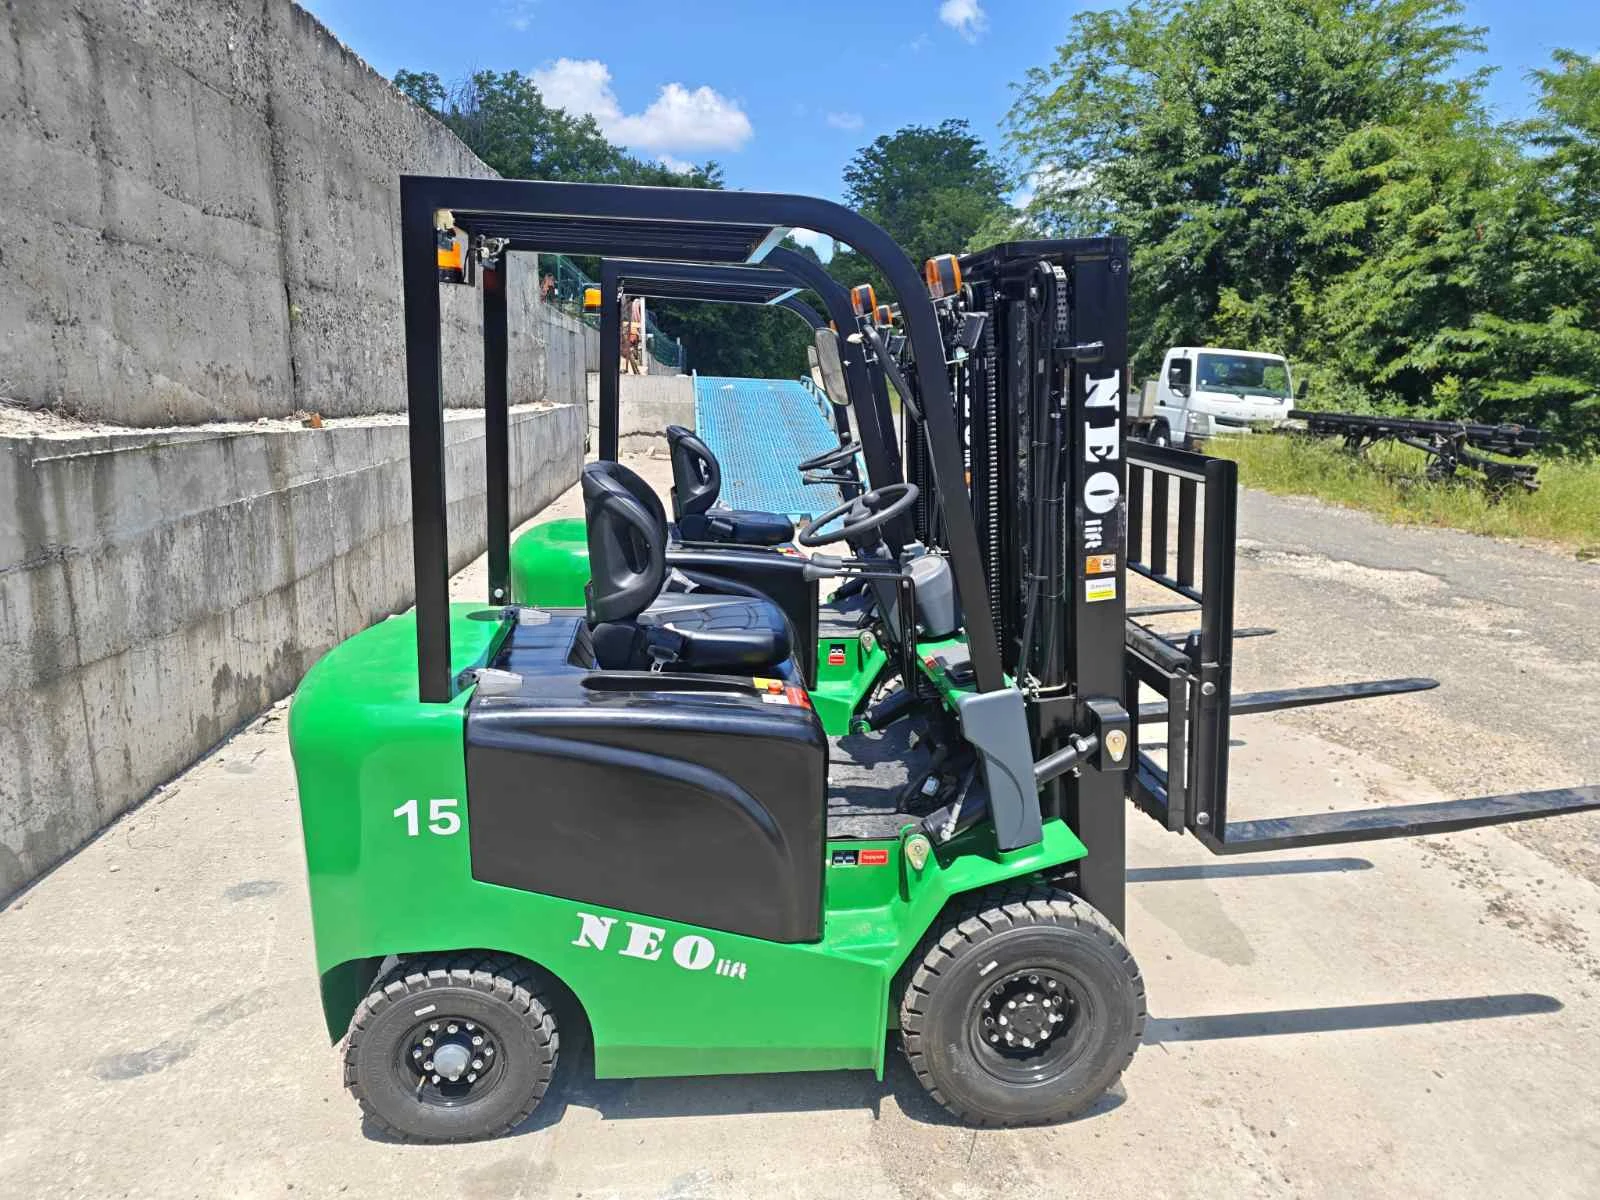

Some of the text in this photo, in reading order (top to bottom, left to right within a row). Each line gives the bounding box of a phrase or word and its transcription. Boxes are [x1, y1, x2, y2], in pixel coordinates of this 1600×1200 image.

[1084, 369, 1120, 549] NEO lift
[393, 798, 461, 836] 15
[571, 912, 748, 980] NEO lift
